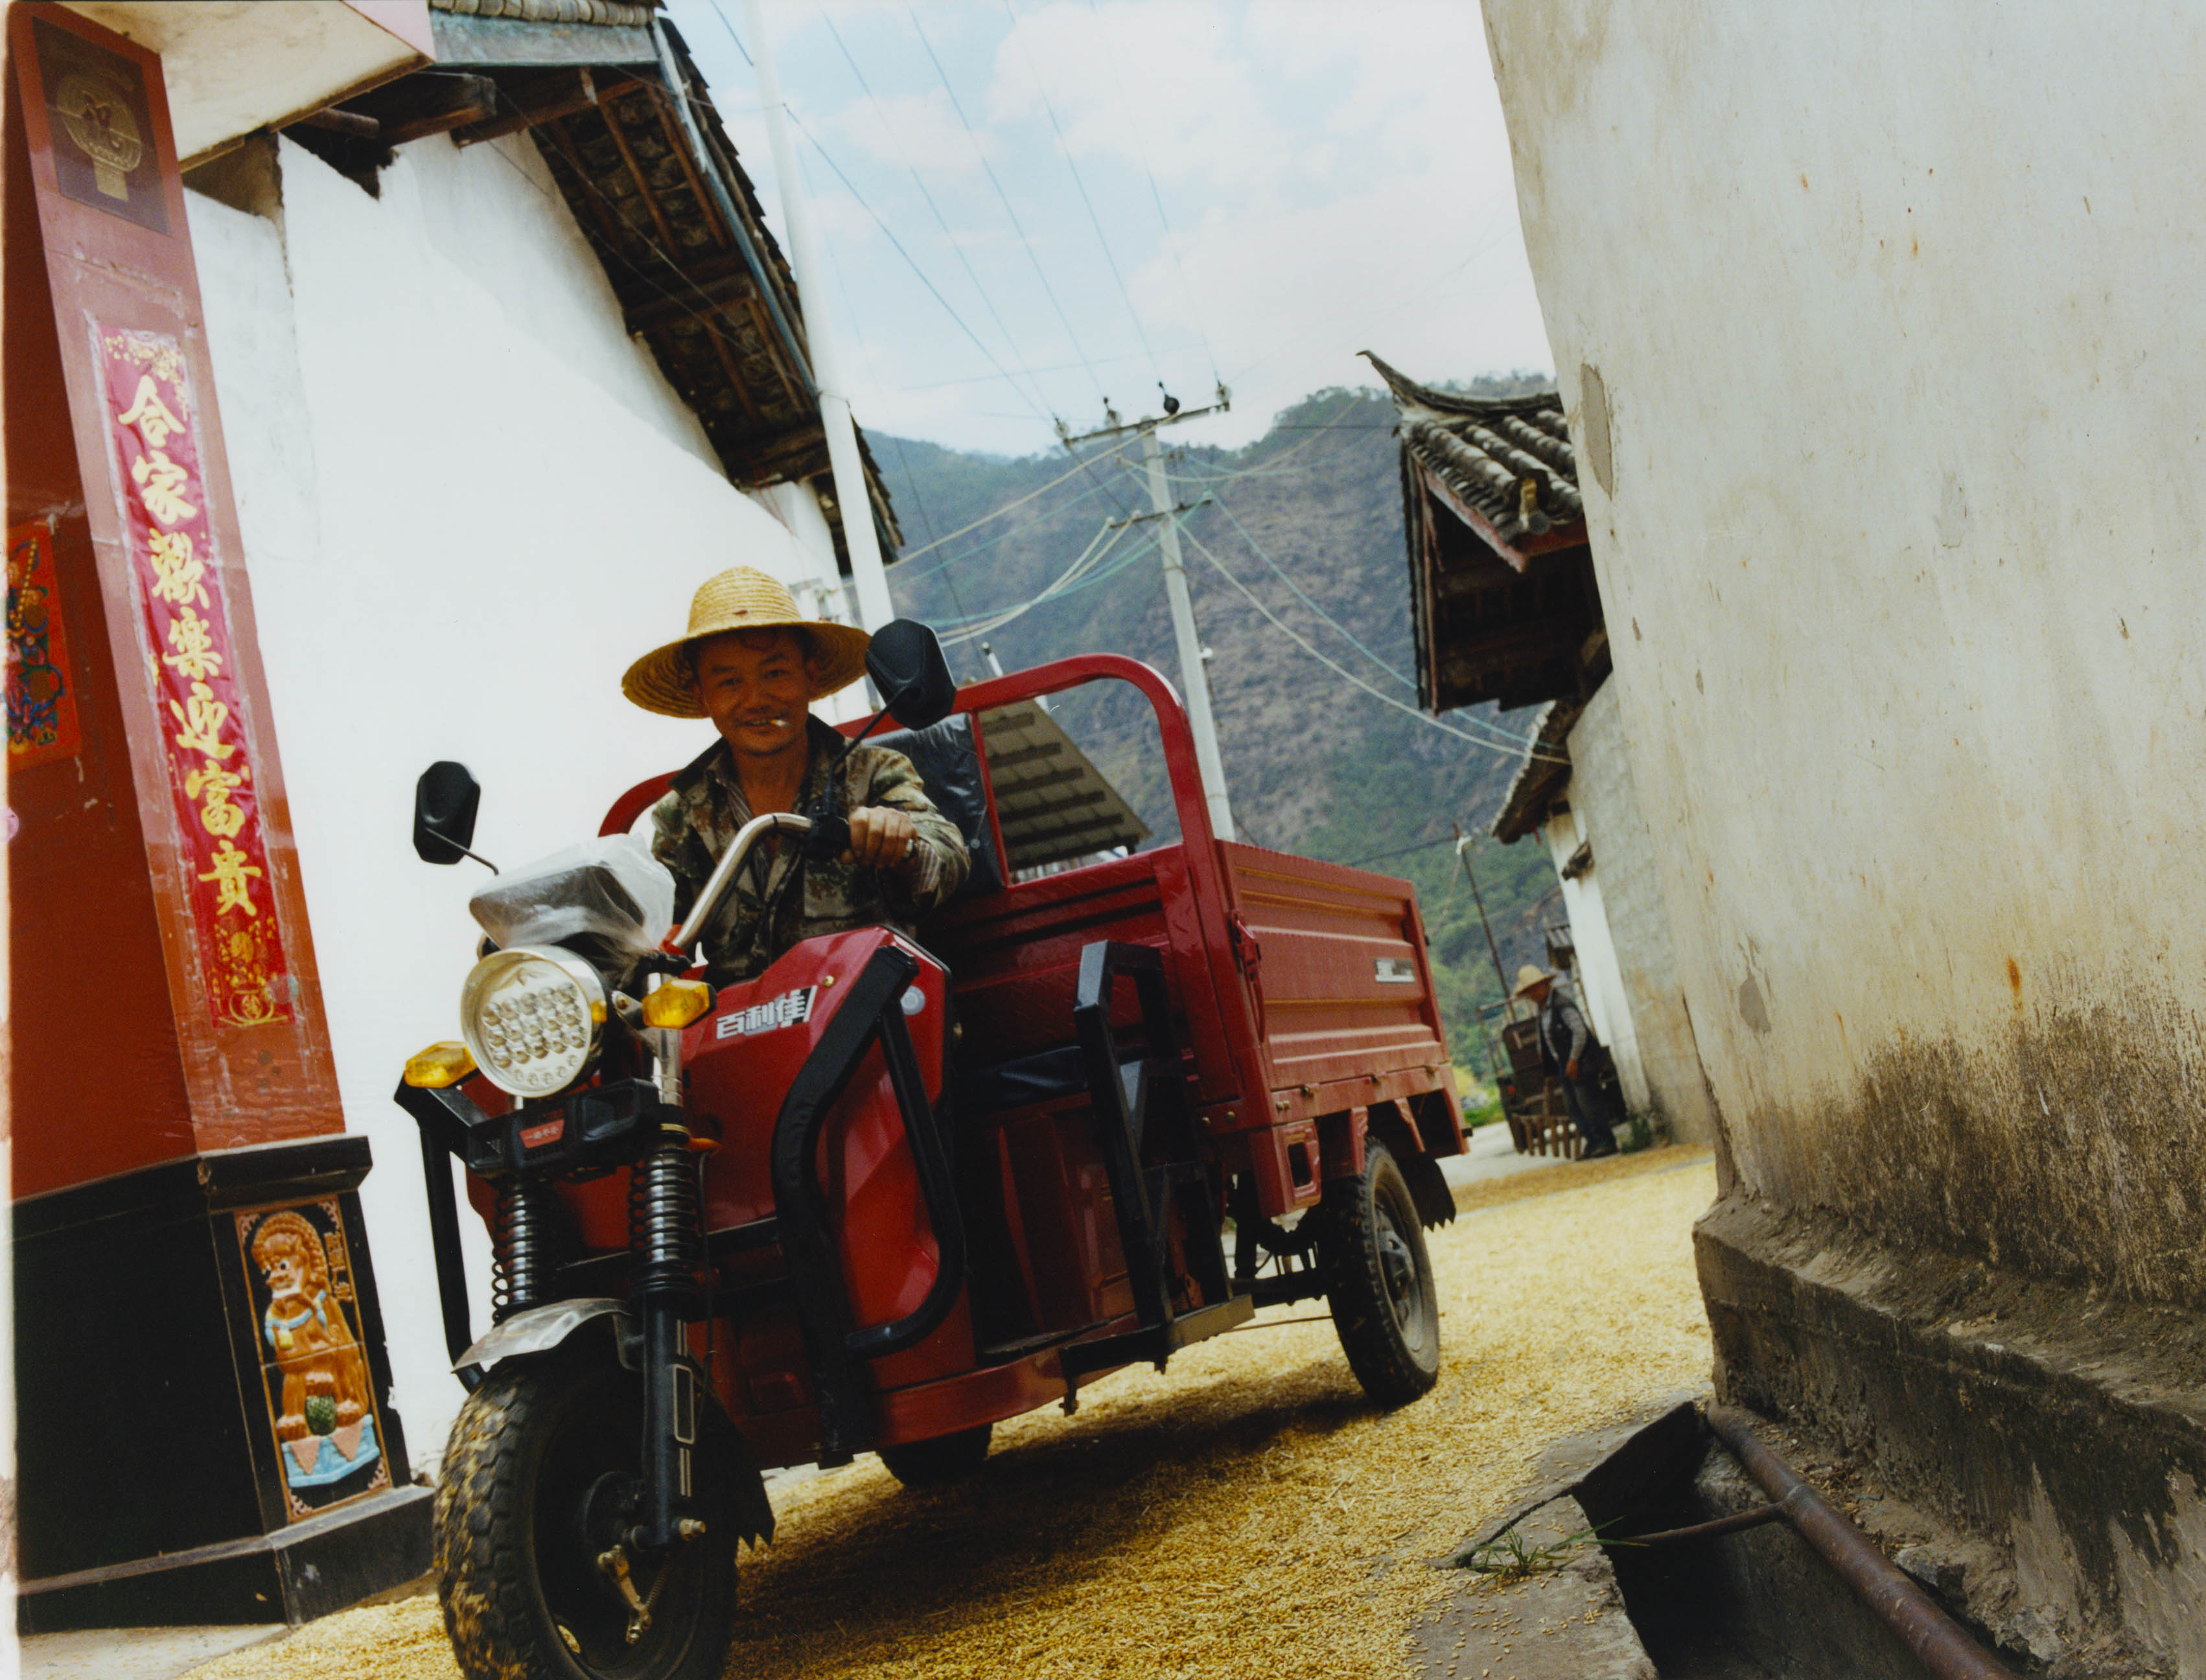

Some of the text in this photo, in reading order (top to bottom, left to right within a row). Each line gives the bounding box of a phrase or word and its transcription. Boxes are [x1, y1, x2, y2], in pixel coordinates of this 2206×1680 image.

[119, 374, 262, 917] 合家歡樂迎富貴
